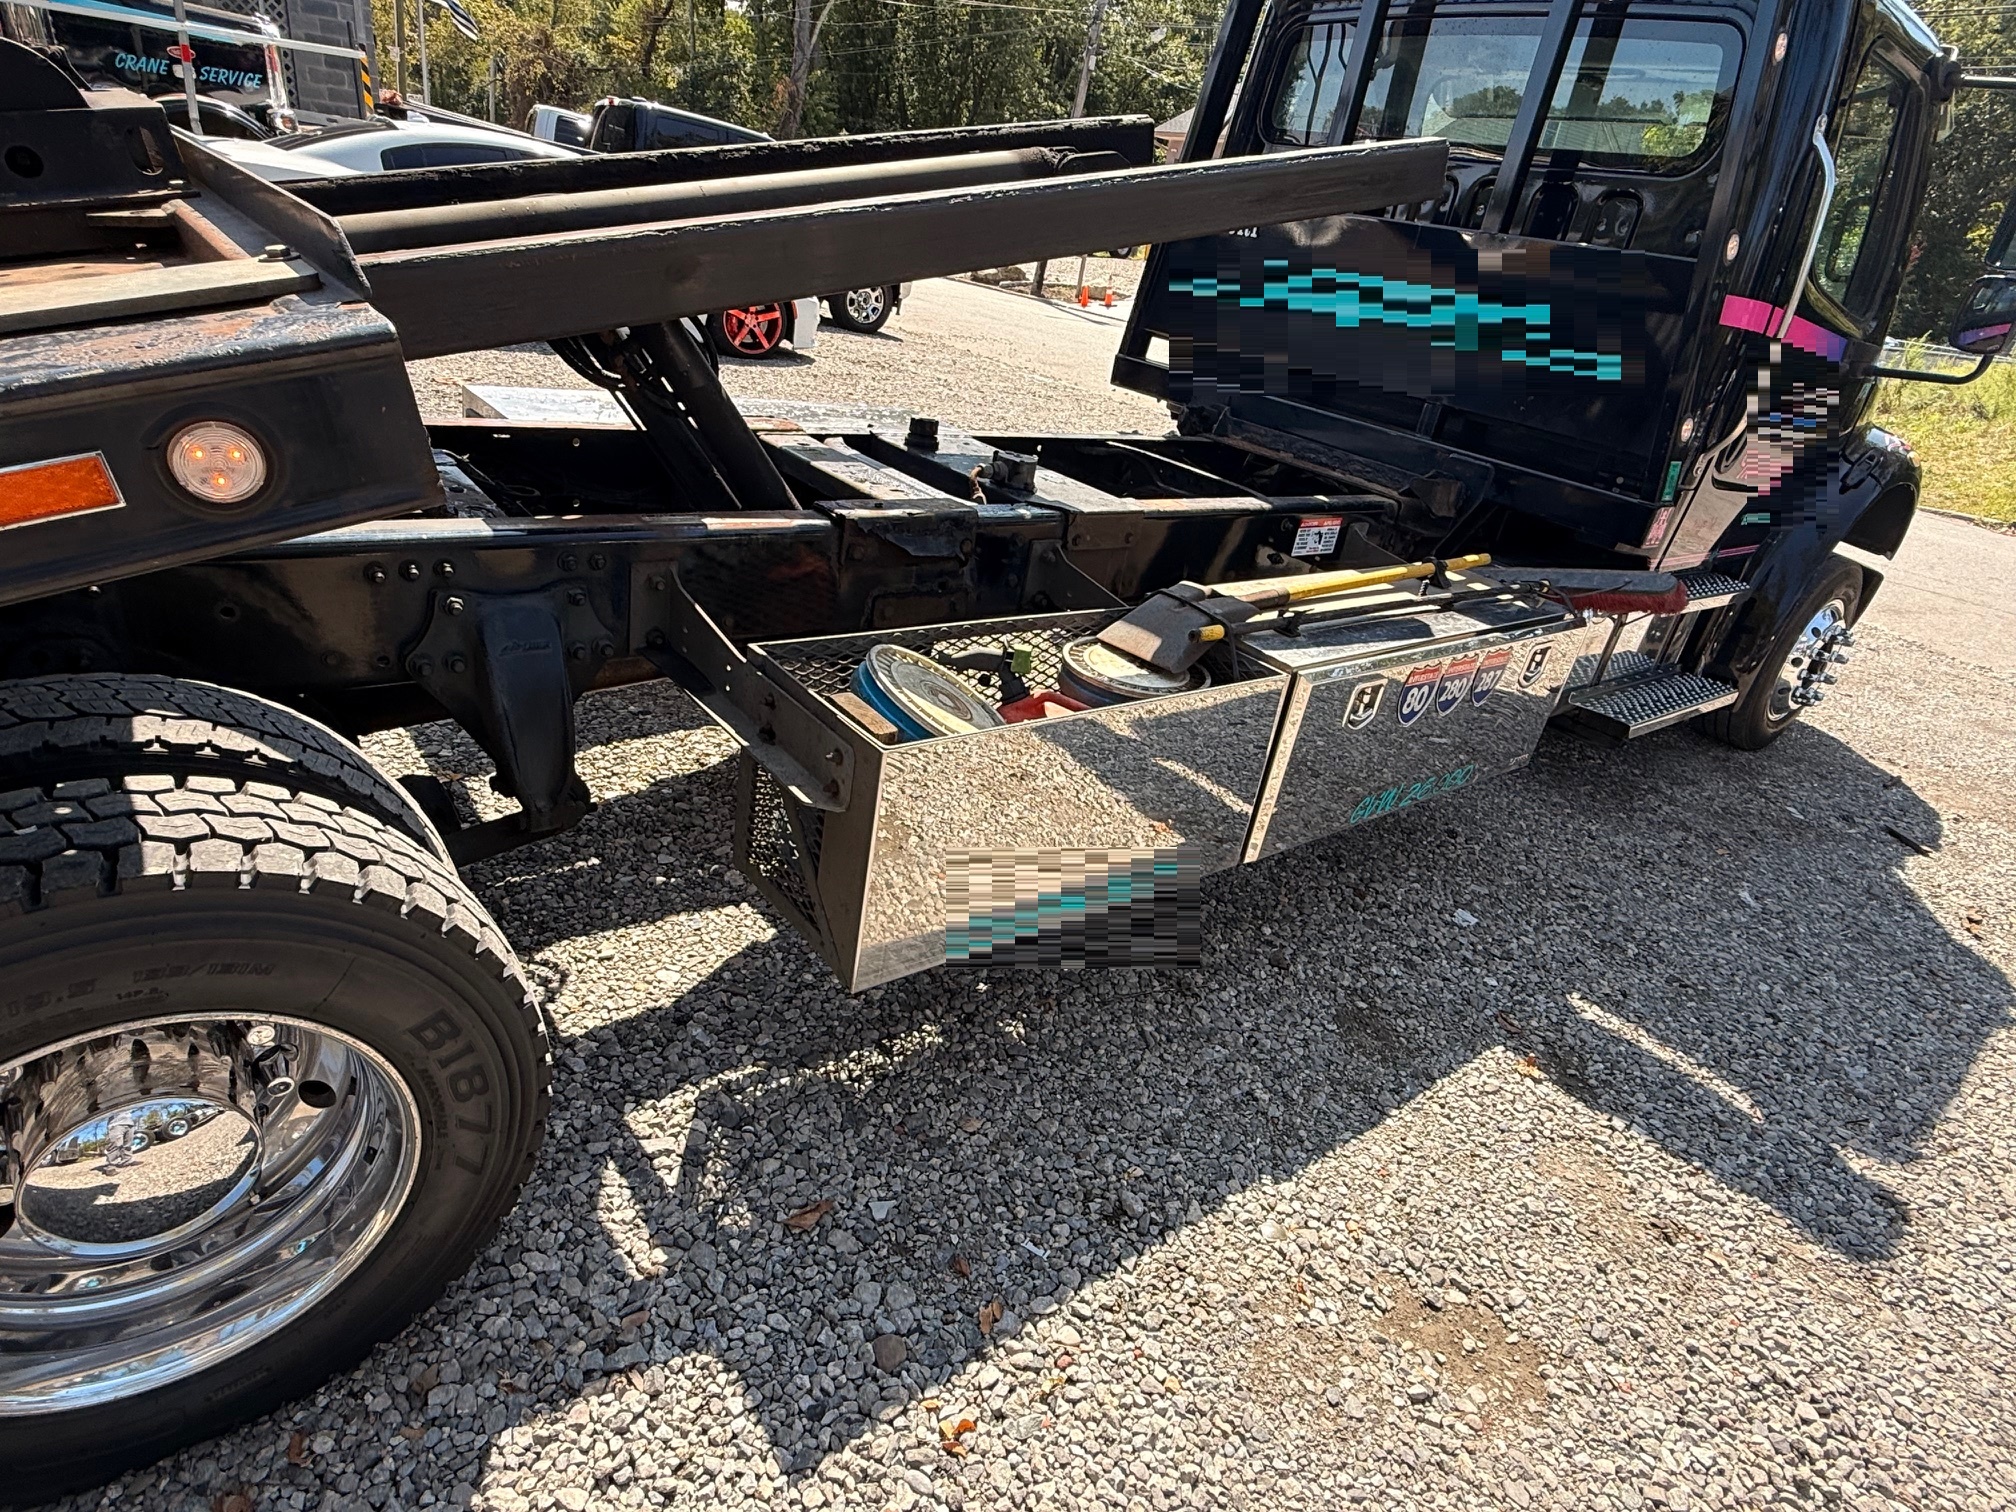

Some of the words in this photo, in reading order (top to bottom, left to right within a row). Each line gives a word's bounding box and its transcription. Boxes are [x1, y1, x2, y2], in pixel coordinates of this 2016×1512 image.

[115, 53, 170, 75] CRANE
[199, 66, 263, 89] SERVICE
[1439, 677, 1468, 702] 280
[1475, 669, 1503, 693] 287
[1402, 685, 1429, 715] 80
